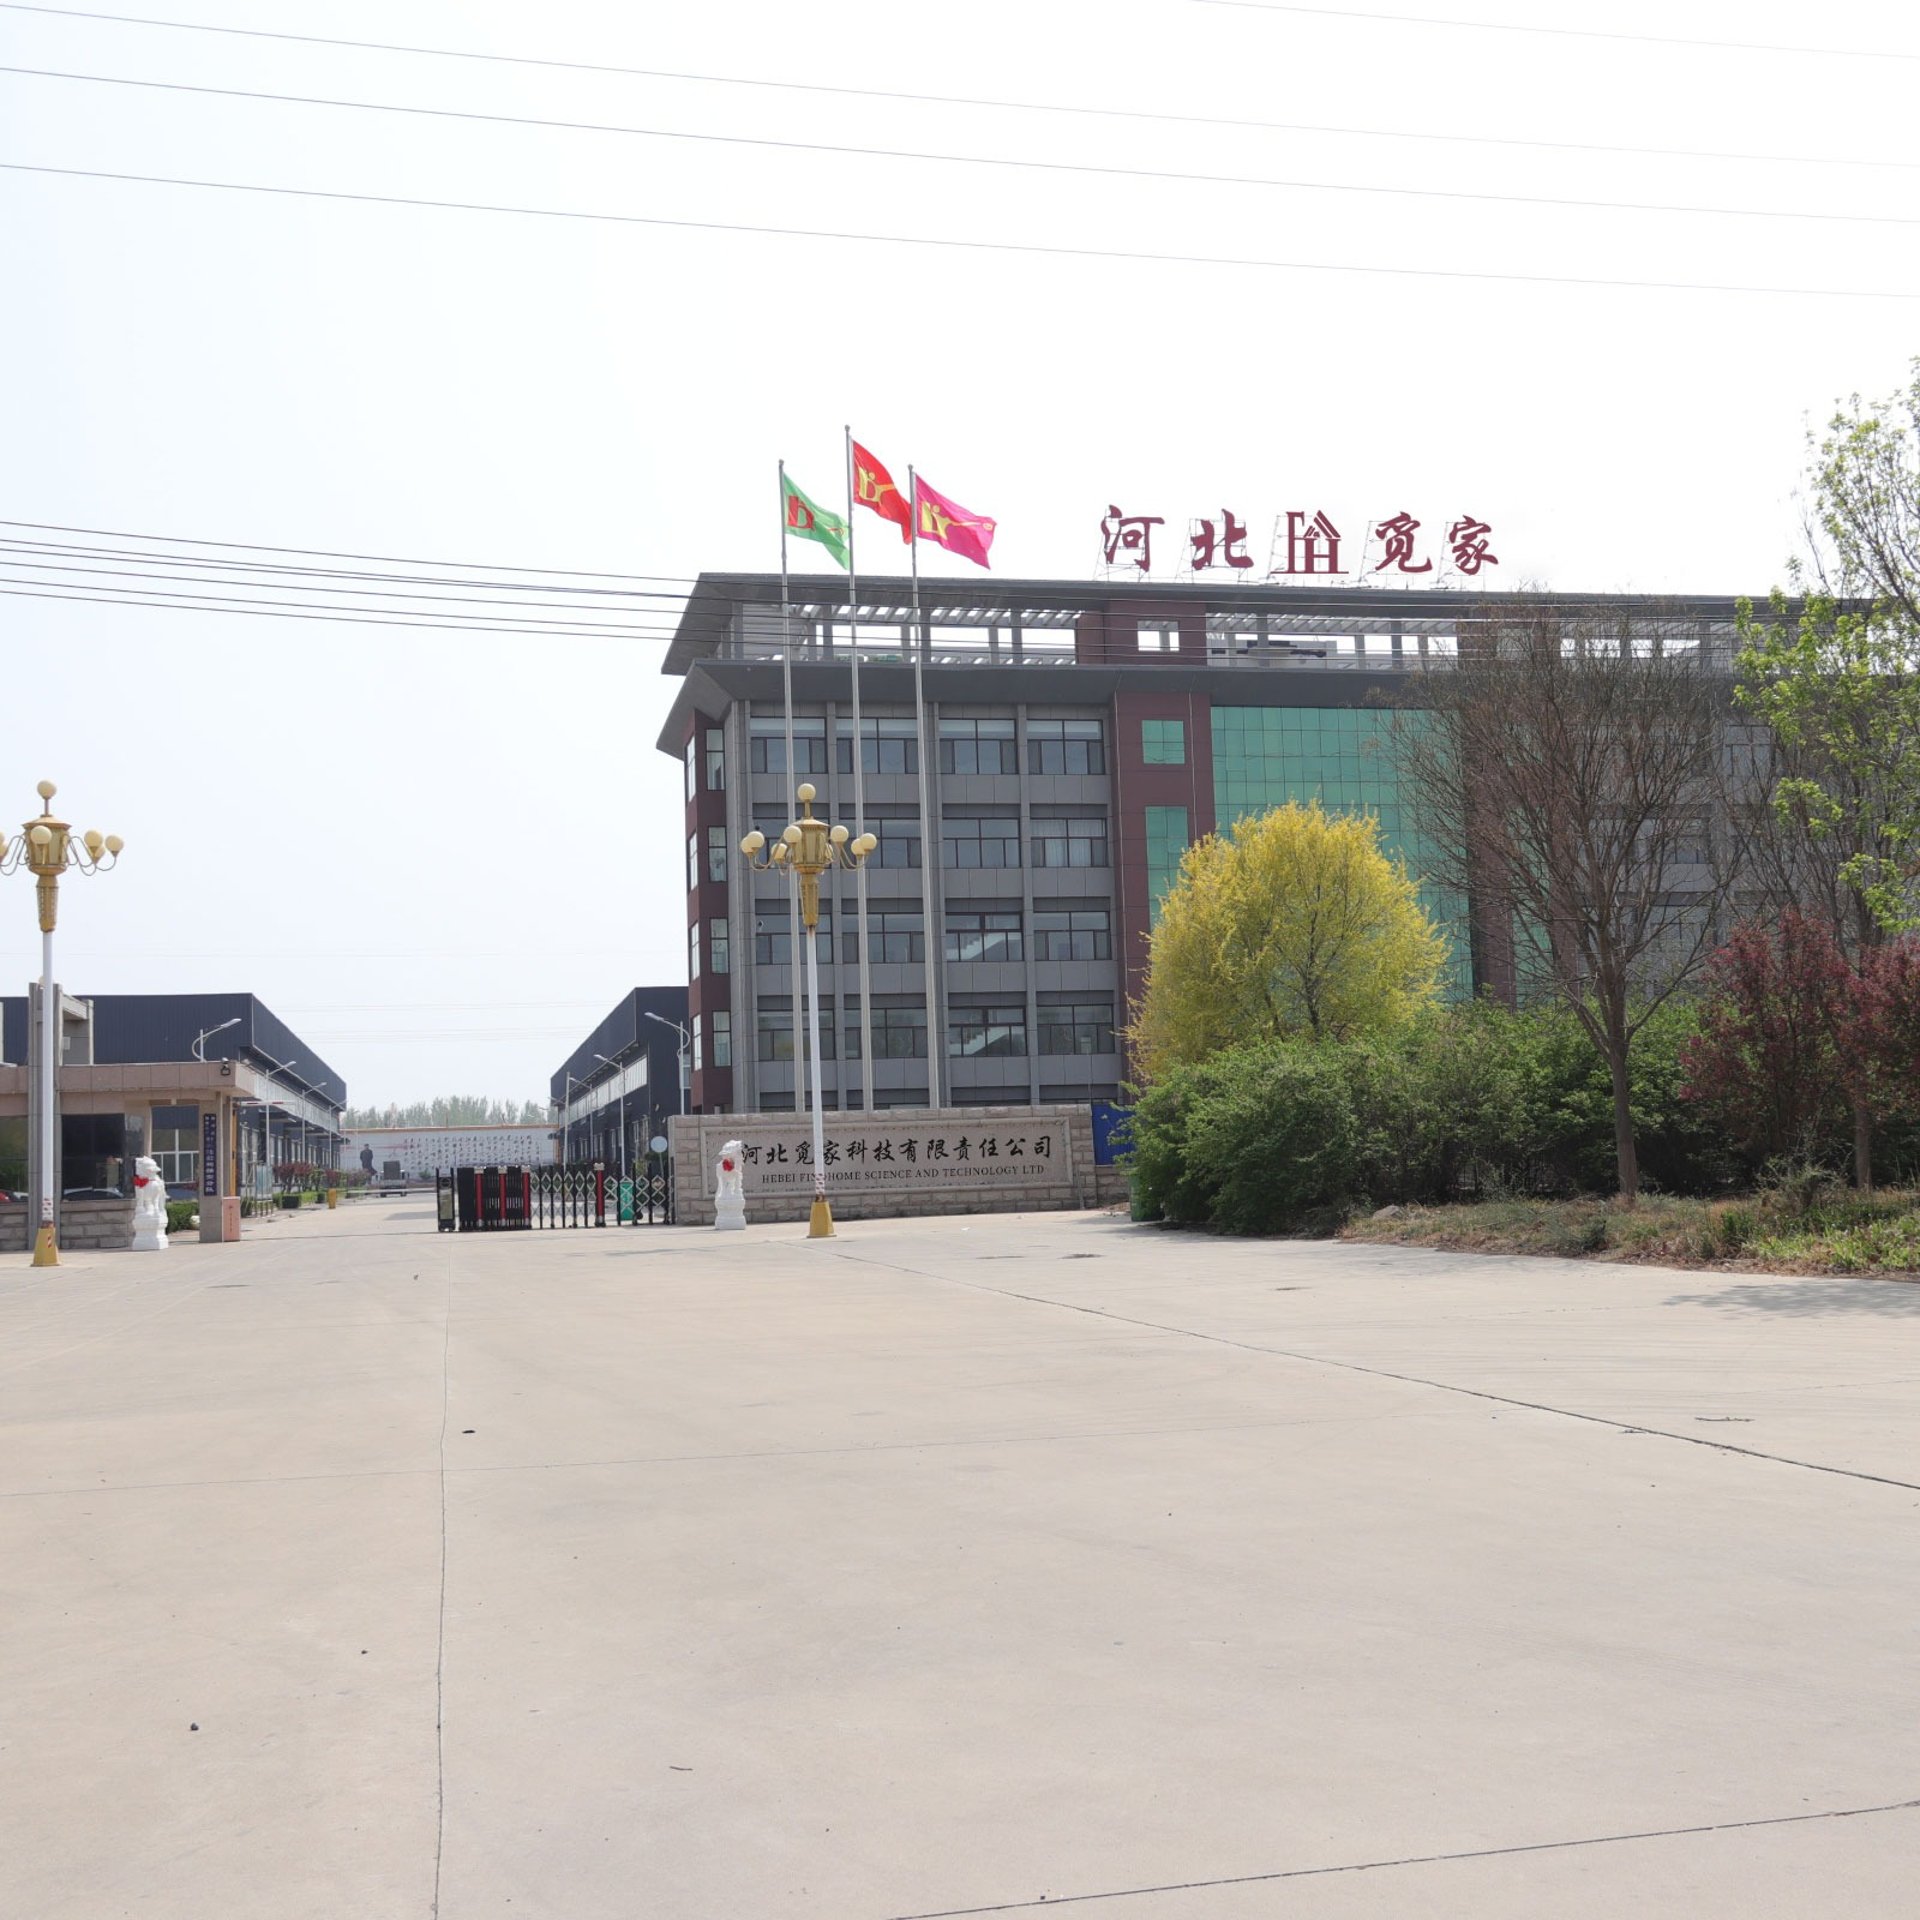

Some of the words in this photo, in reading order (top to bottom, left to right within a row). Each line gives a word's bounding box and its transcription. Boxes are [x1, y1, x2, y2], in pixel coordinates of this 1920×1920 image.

[1101, 504, 1254, 573] 河北
[1374, 511, 1499, 576] 觅家
[741, 1135, 1052, 1166] 河北觅家科技有限责任公司
[762, 1173, 796, 1184] HEBEI
[864, 1169, 913, 1181] SCIENCE
[915, 1168, 939, 1179] AND
[943, 1165, 1019, 1178] TECHNOLOGY
[1022, 1164, 1045, 1175] LTD
